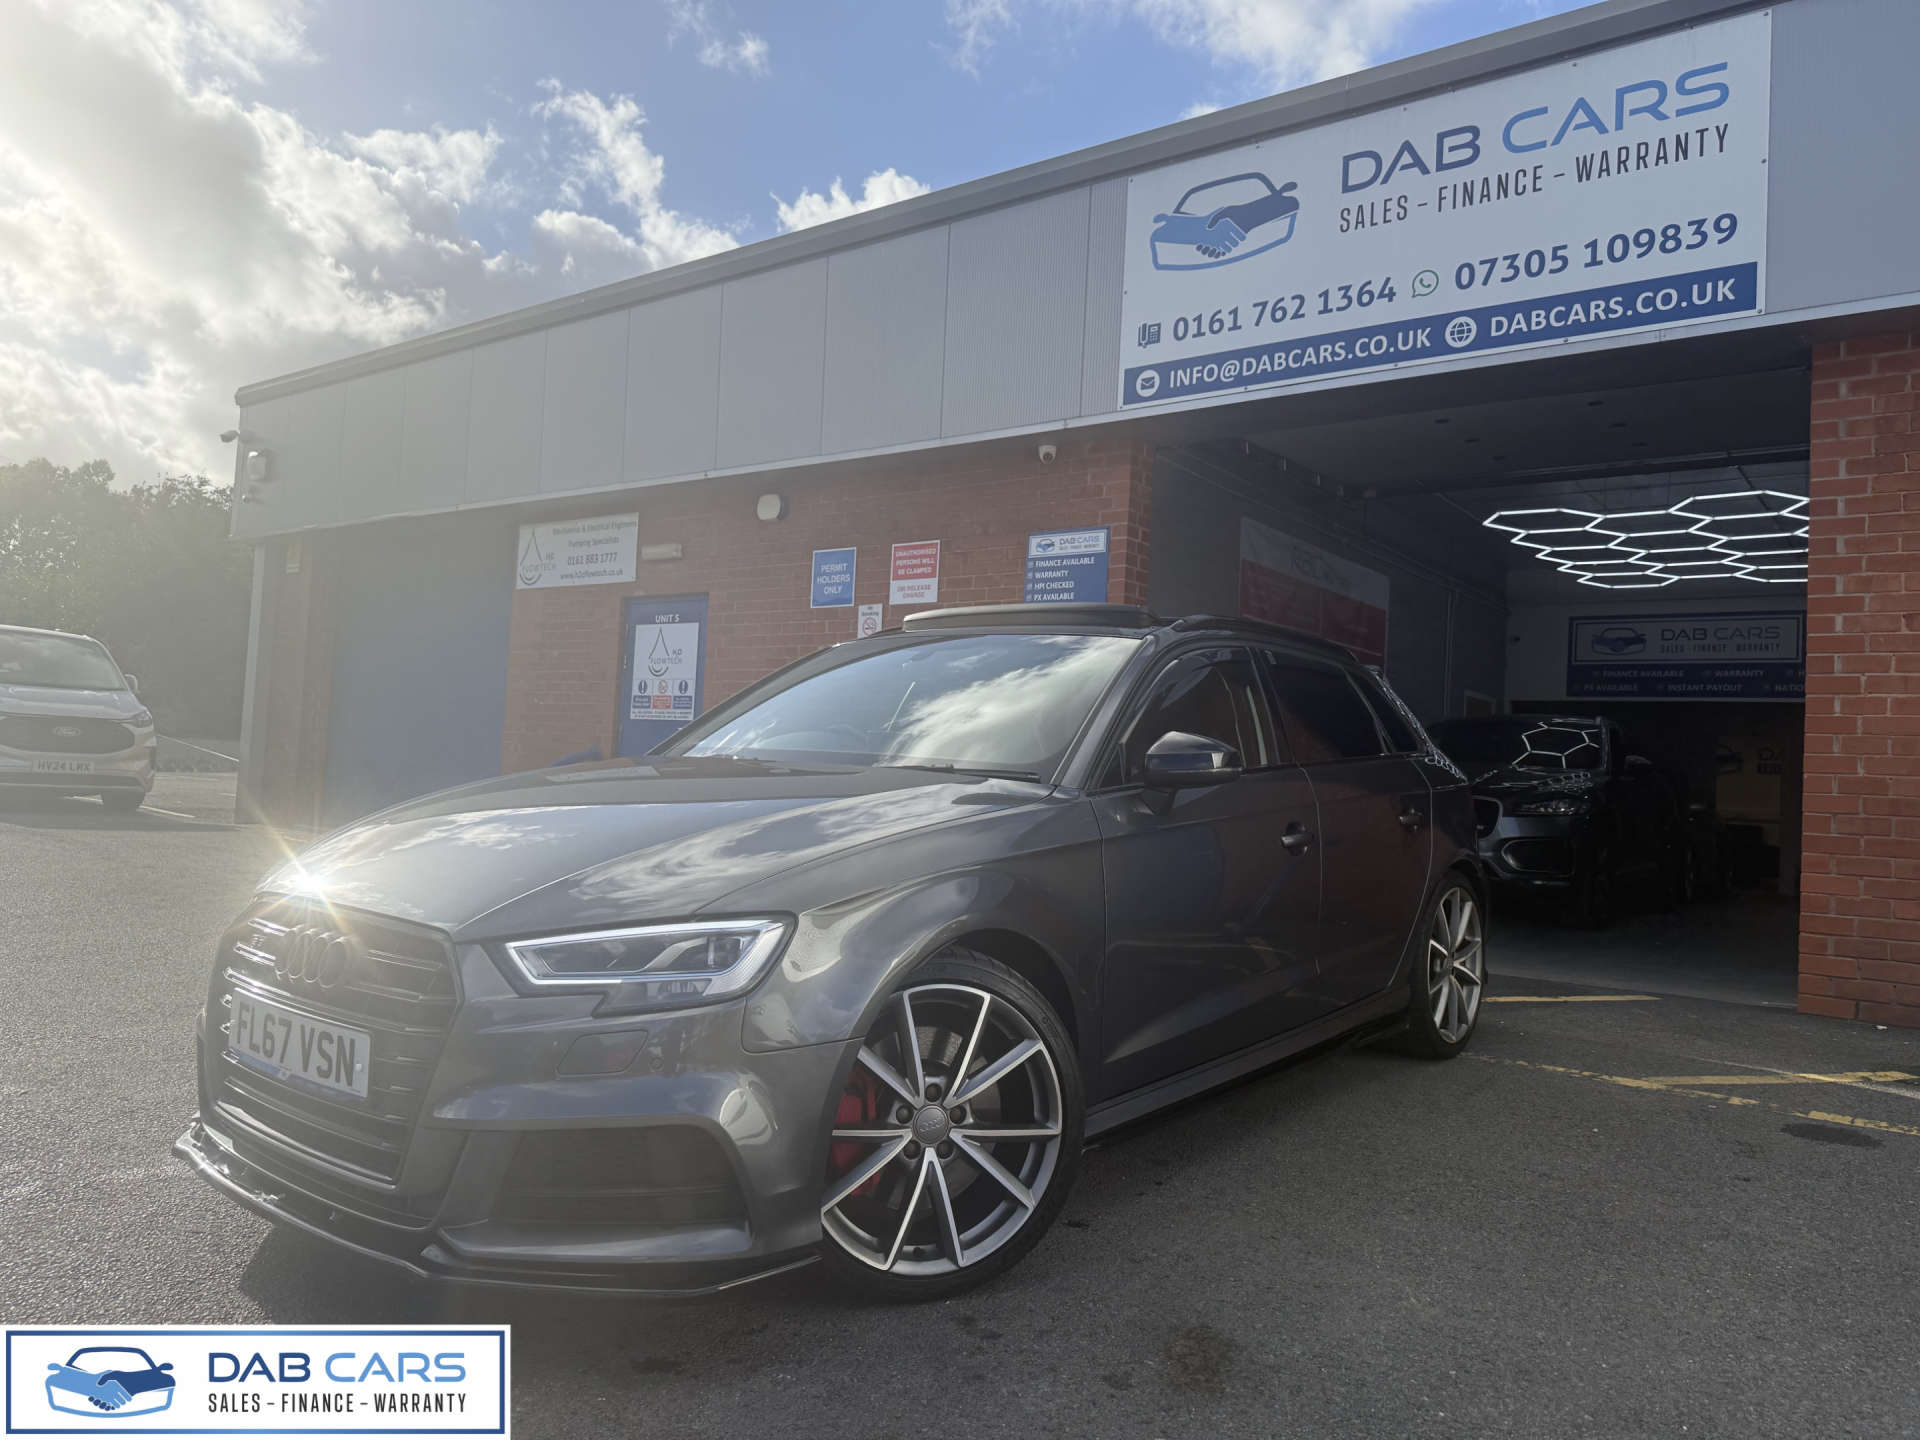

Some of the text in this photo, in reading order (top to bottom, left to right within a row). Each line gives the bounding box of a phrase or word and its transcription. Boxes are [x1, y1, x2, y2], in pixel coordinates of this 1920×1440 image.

[1341, 61, 1729, 194] DAB CARS
[1339, 195, 1409, 234] SALES
[1437, 165, 1543, 213] FINANCE
[1574, 123, 1730, 185] WARRANTY
[1454, 211, 1738, 291] 07305 109839
[1172, 276, 1397, 342] 0161 762 1364
[1490, 276, 1736, 337] DABCARS.CO.UK
[1169, 325, 1432, 389] INFO@DABCARS.CO.UK
[1035, 556, 1095, 568] FINANCE AVAILABLE
[820, 563, 849, 574] PERMIT
[816, 573, 851, 584] HOLDERS
[1034, 570, 1069, 579] WARRANTY
[823, 585, 843, 595] ONLY
[1046, 581, 1075, 590] CHECKED
[1043, 592, 1075, 601] AVAILABLE
[655, 614, 673, 624] UNIT
[1660, 625, 1782, 642] DAB CARS
[1713, 669, 1765, 678] WARRANTY
[1705, 683, 1743, 692] PAYOUT
[236, 1001, 356, 1088] FL67 VSN
